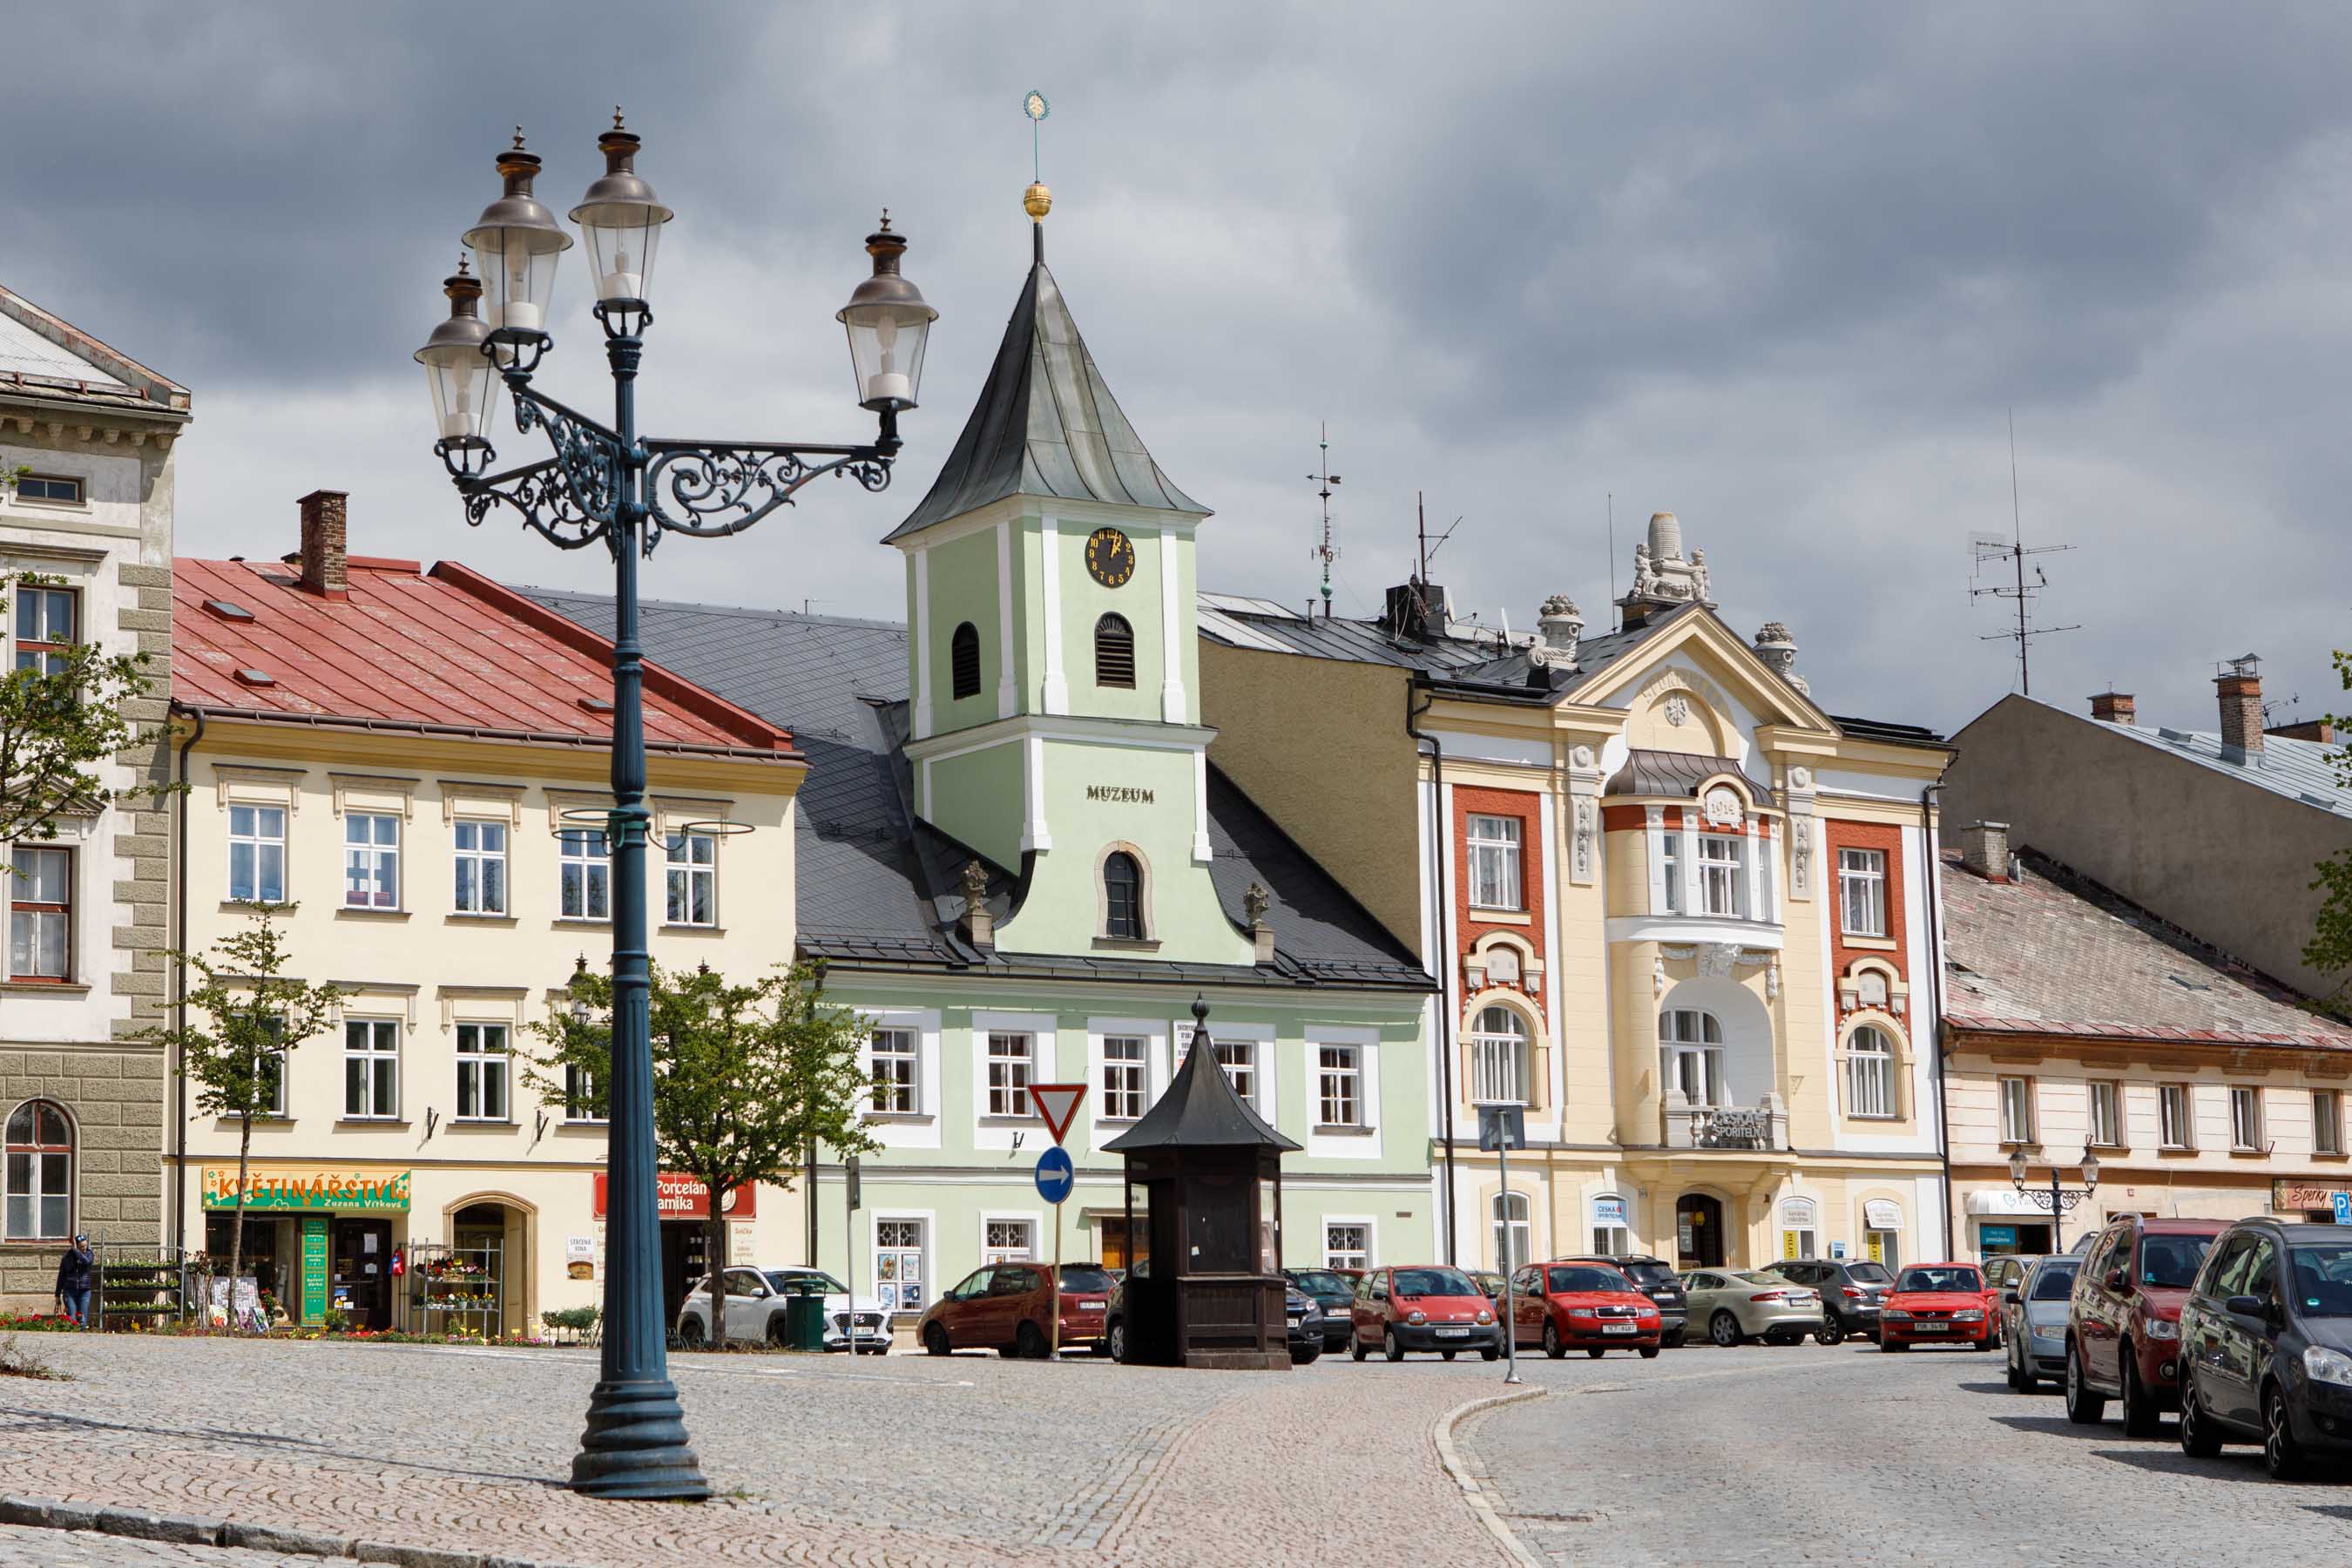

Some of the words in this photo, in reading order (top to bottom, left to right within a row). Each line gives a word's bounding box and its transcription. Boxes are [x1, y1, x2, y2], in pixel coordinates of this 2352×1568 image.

[1099, 571, 1105, 581] 7
[1108, 575, 1114, 585] 6
[1118, 574, 1124, 584] 5
[1086, 784, 1154, 804] MUZEUM
[219, 1173, 398, 1199] KVĚTINÁŘSTVÍ
[324, 1199, 360, 1207] Zuzana
[364, 1199, 402, 1208] Vítková
[658, 1196, 693, 1210] amika
[2336, 1197, 2347, 1216] P
